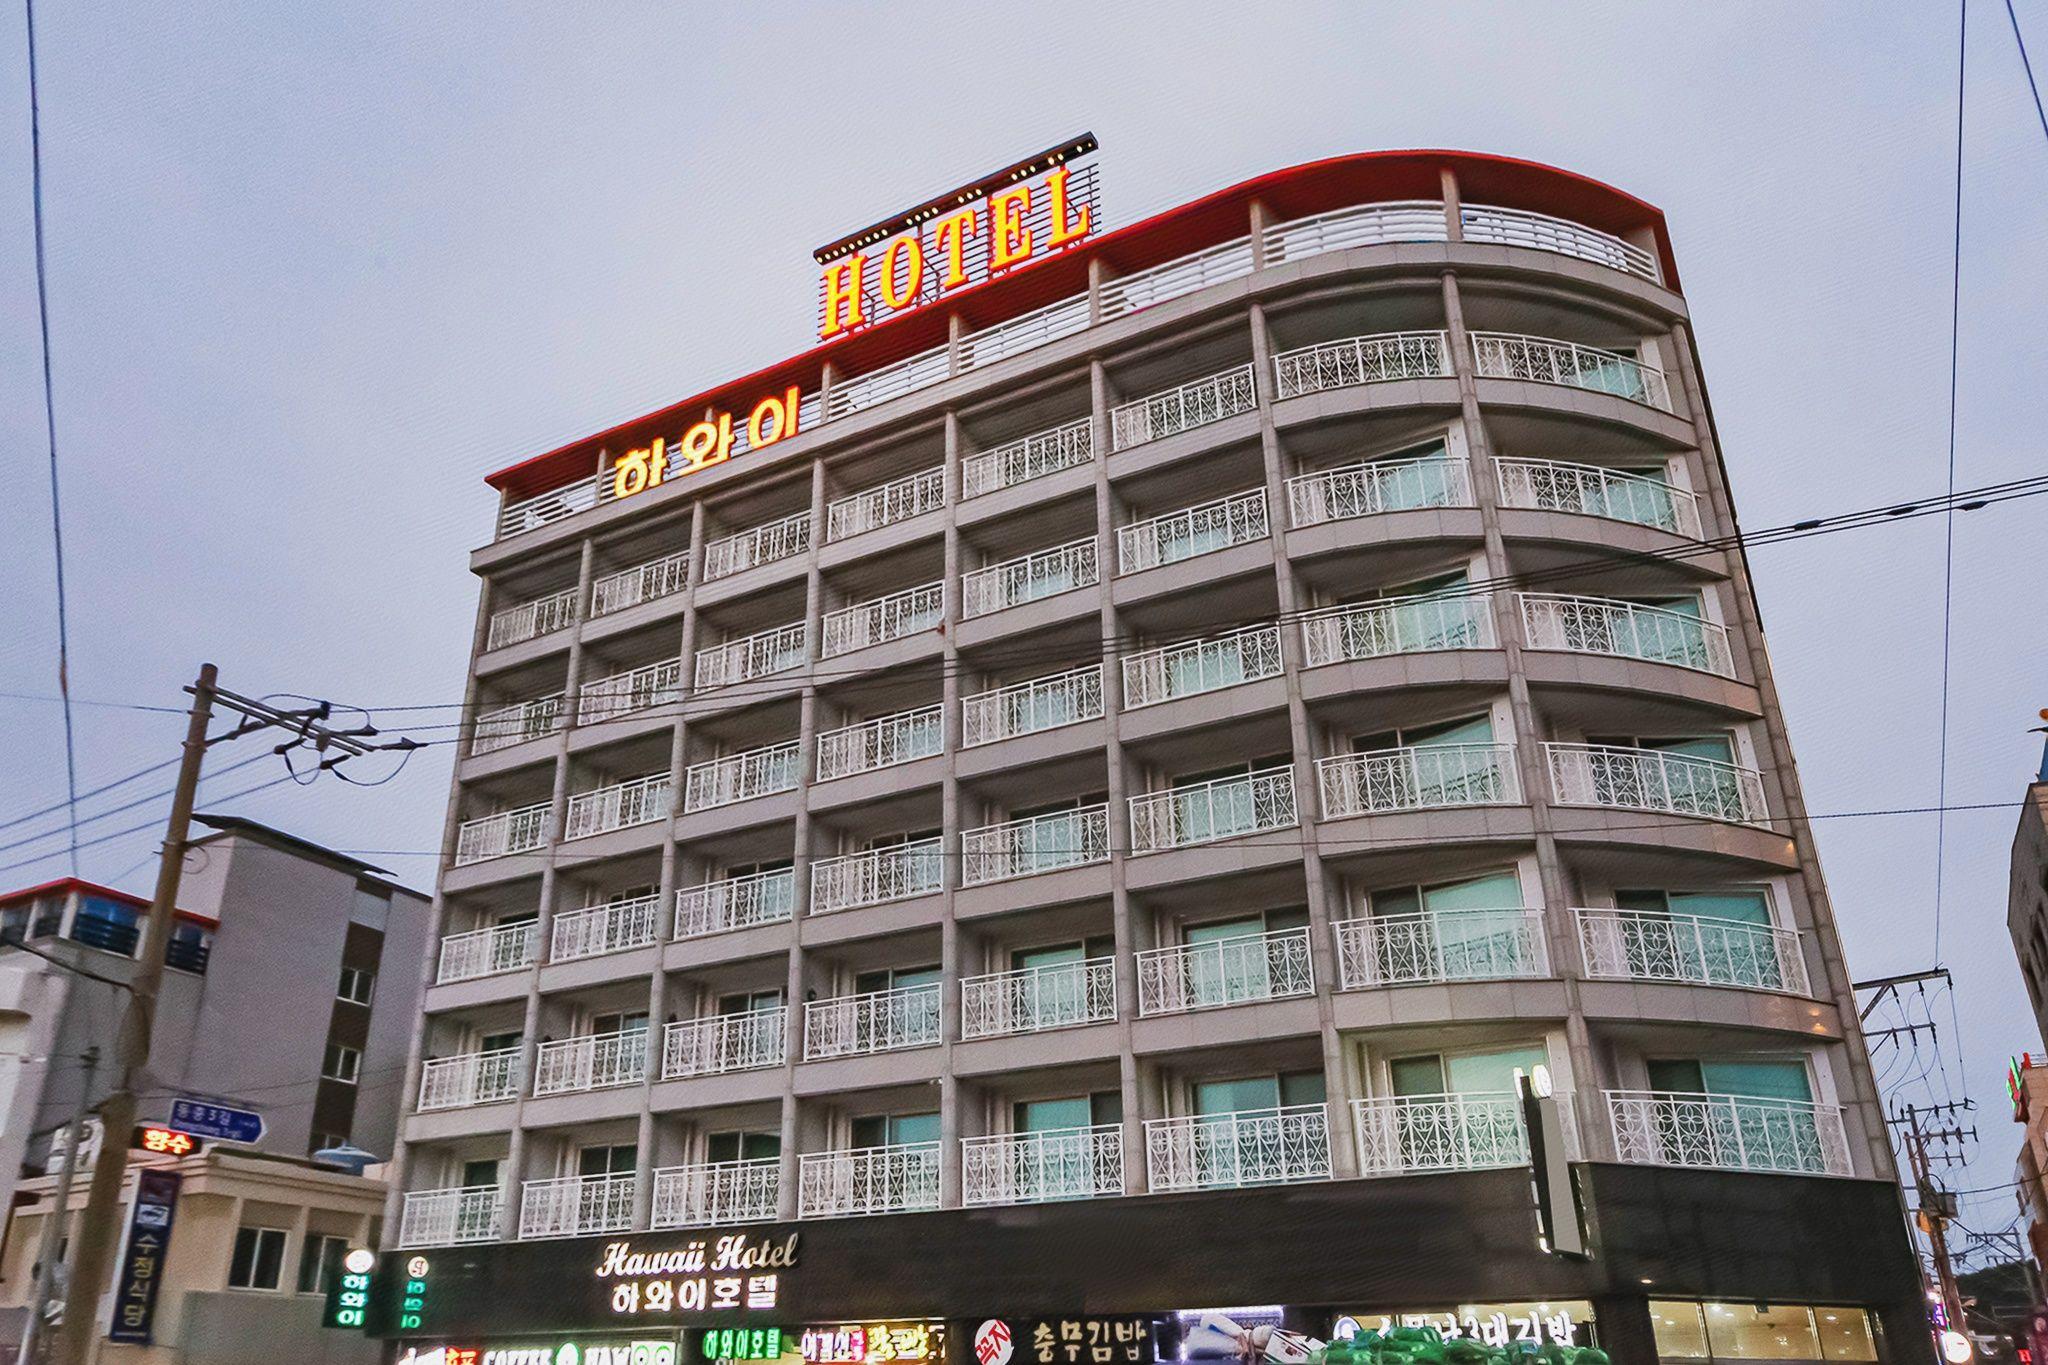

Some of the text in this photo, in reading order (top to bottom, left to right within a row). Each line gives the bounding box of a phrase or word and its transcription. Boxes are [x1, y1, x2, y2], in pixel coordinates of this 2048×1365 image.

[820, 165, 1092, 341] HOTEL
[614, 385, 799, 500] 하와이
[595, 1232, 799, 1278] Hawaii Hotel
[123, 1233, 160, 1328] 수정식당
[337, 1274, 369, 1326] 하와이
[612, 1274, 778, 1314] 하와이호텔
[703, 1327, 781, 1360] 하와이호텔
[1033, 1320, 1148, 1363] 충무김밥
